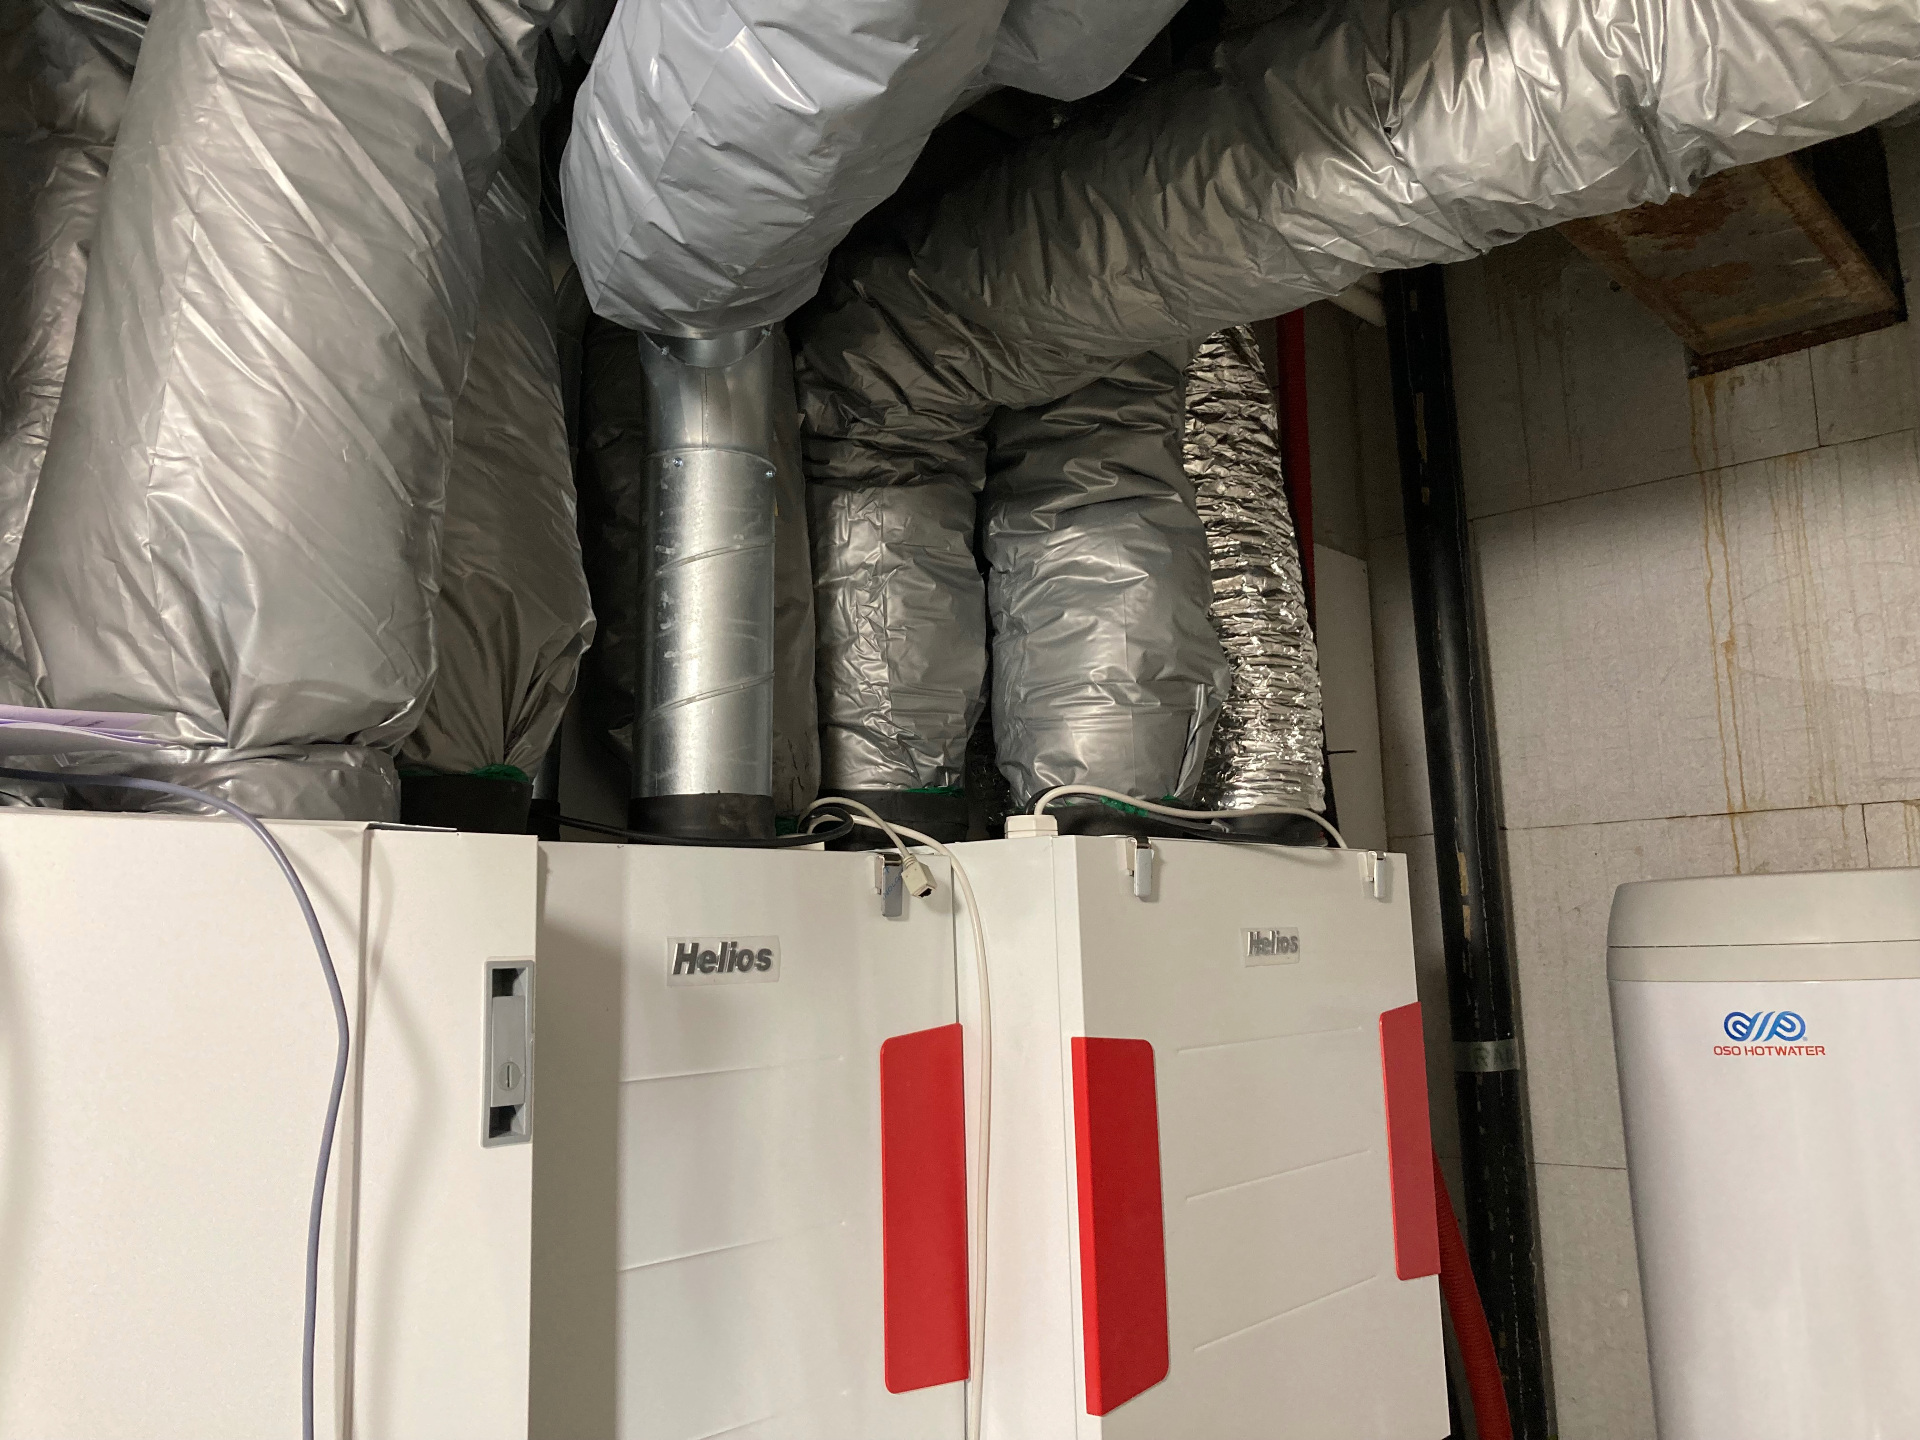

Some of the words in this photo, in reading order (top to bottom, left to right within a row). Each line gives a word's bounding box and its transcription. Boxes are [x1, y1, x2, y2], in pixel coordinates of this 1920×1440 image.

[1247, 930, 1299, 956] Helios
[672, 941, 773, 975] Helios
[1713, 1045, 1741, 1056] OSO
[1745, 1045, 1826, 1056] HOTWATER
